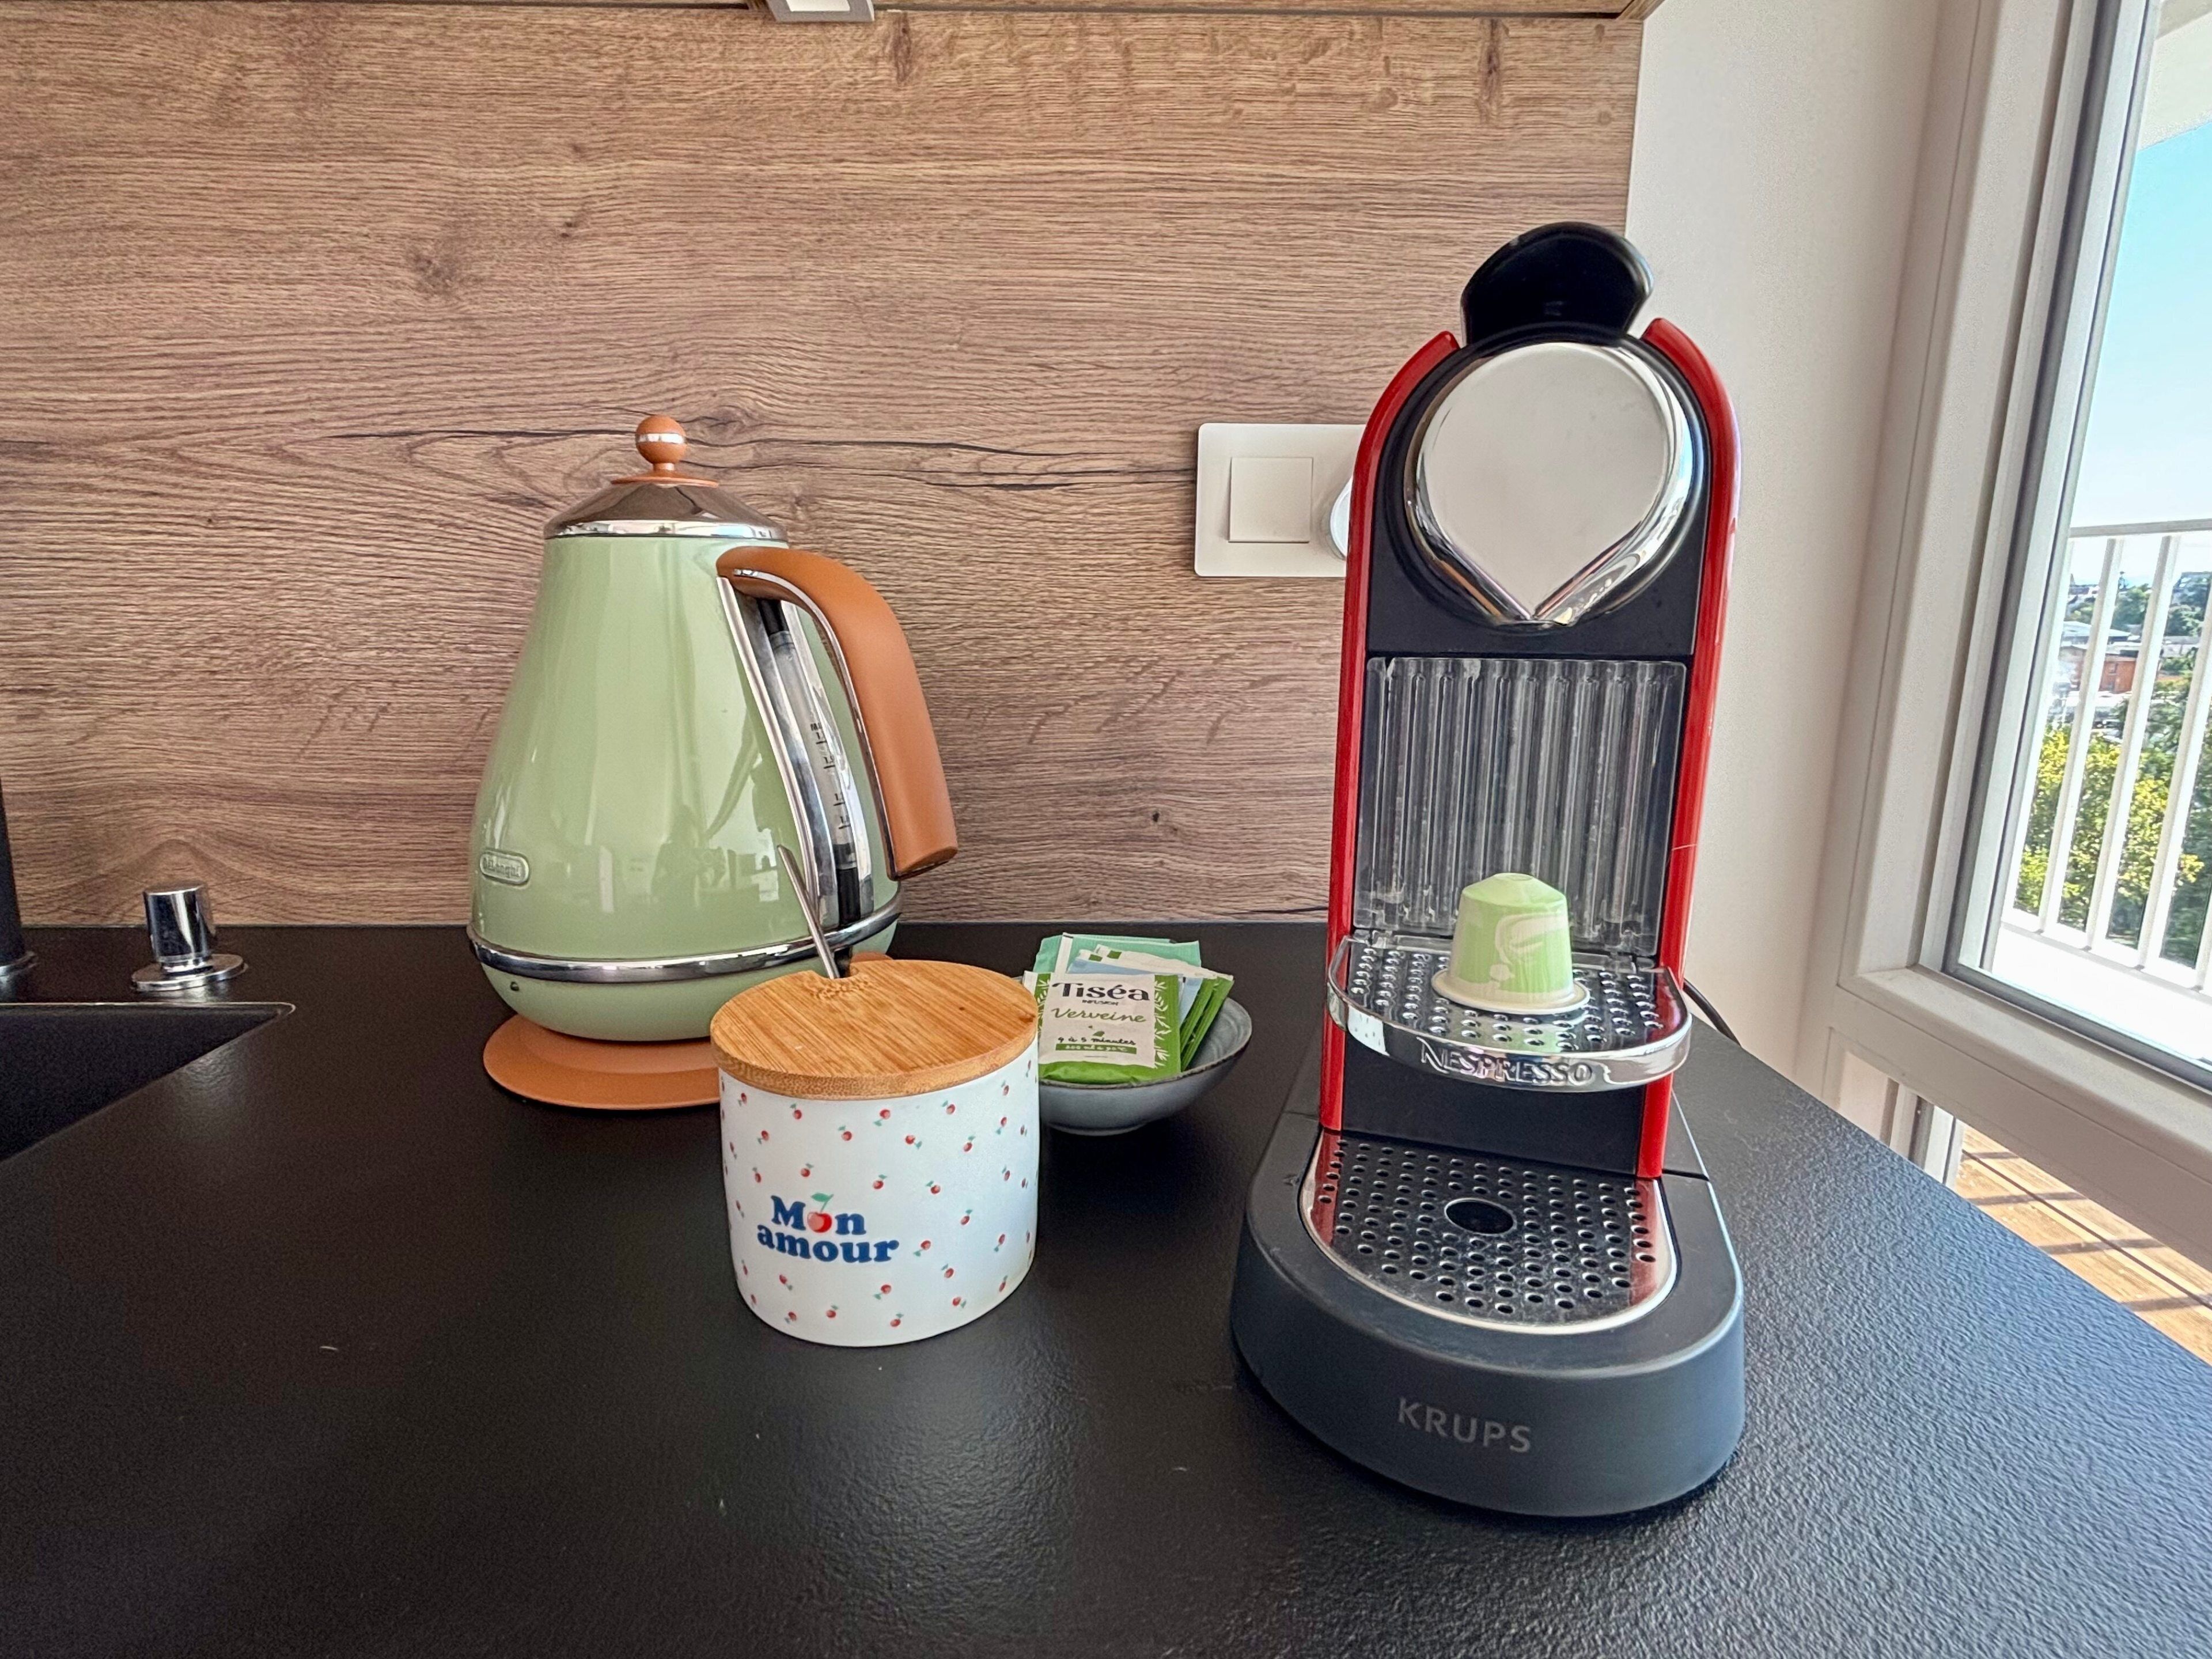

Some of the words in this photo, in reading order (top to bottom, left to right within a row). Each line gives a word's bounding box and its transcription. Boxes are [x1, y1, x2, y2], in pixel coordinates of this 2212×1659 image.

[1052, 982, 1150, 1001] Tiséa
[1051, 1007, 1147, 1022] Verveine
[1090, 1037, 1137, 1046] minutes
[1416, 1036, 1593, 1086] NESPRESSO
[757, 1224, 900, 1263] amour
[1398, 1396, 1531, 1453] KRUPS
